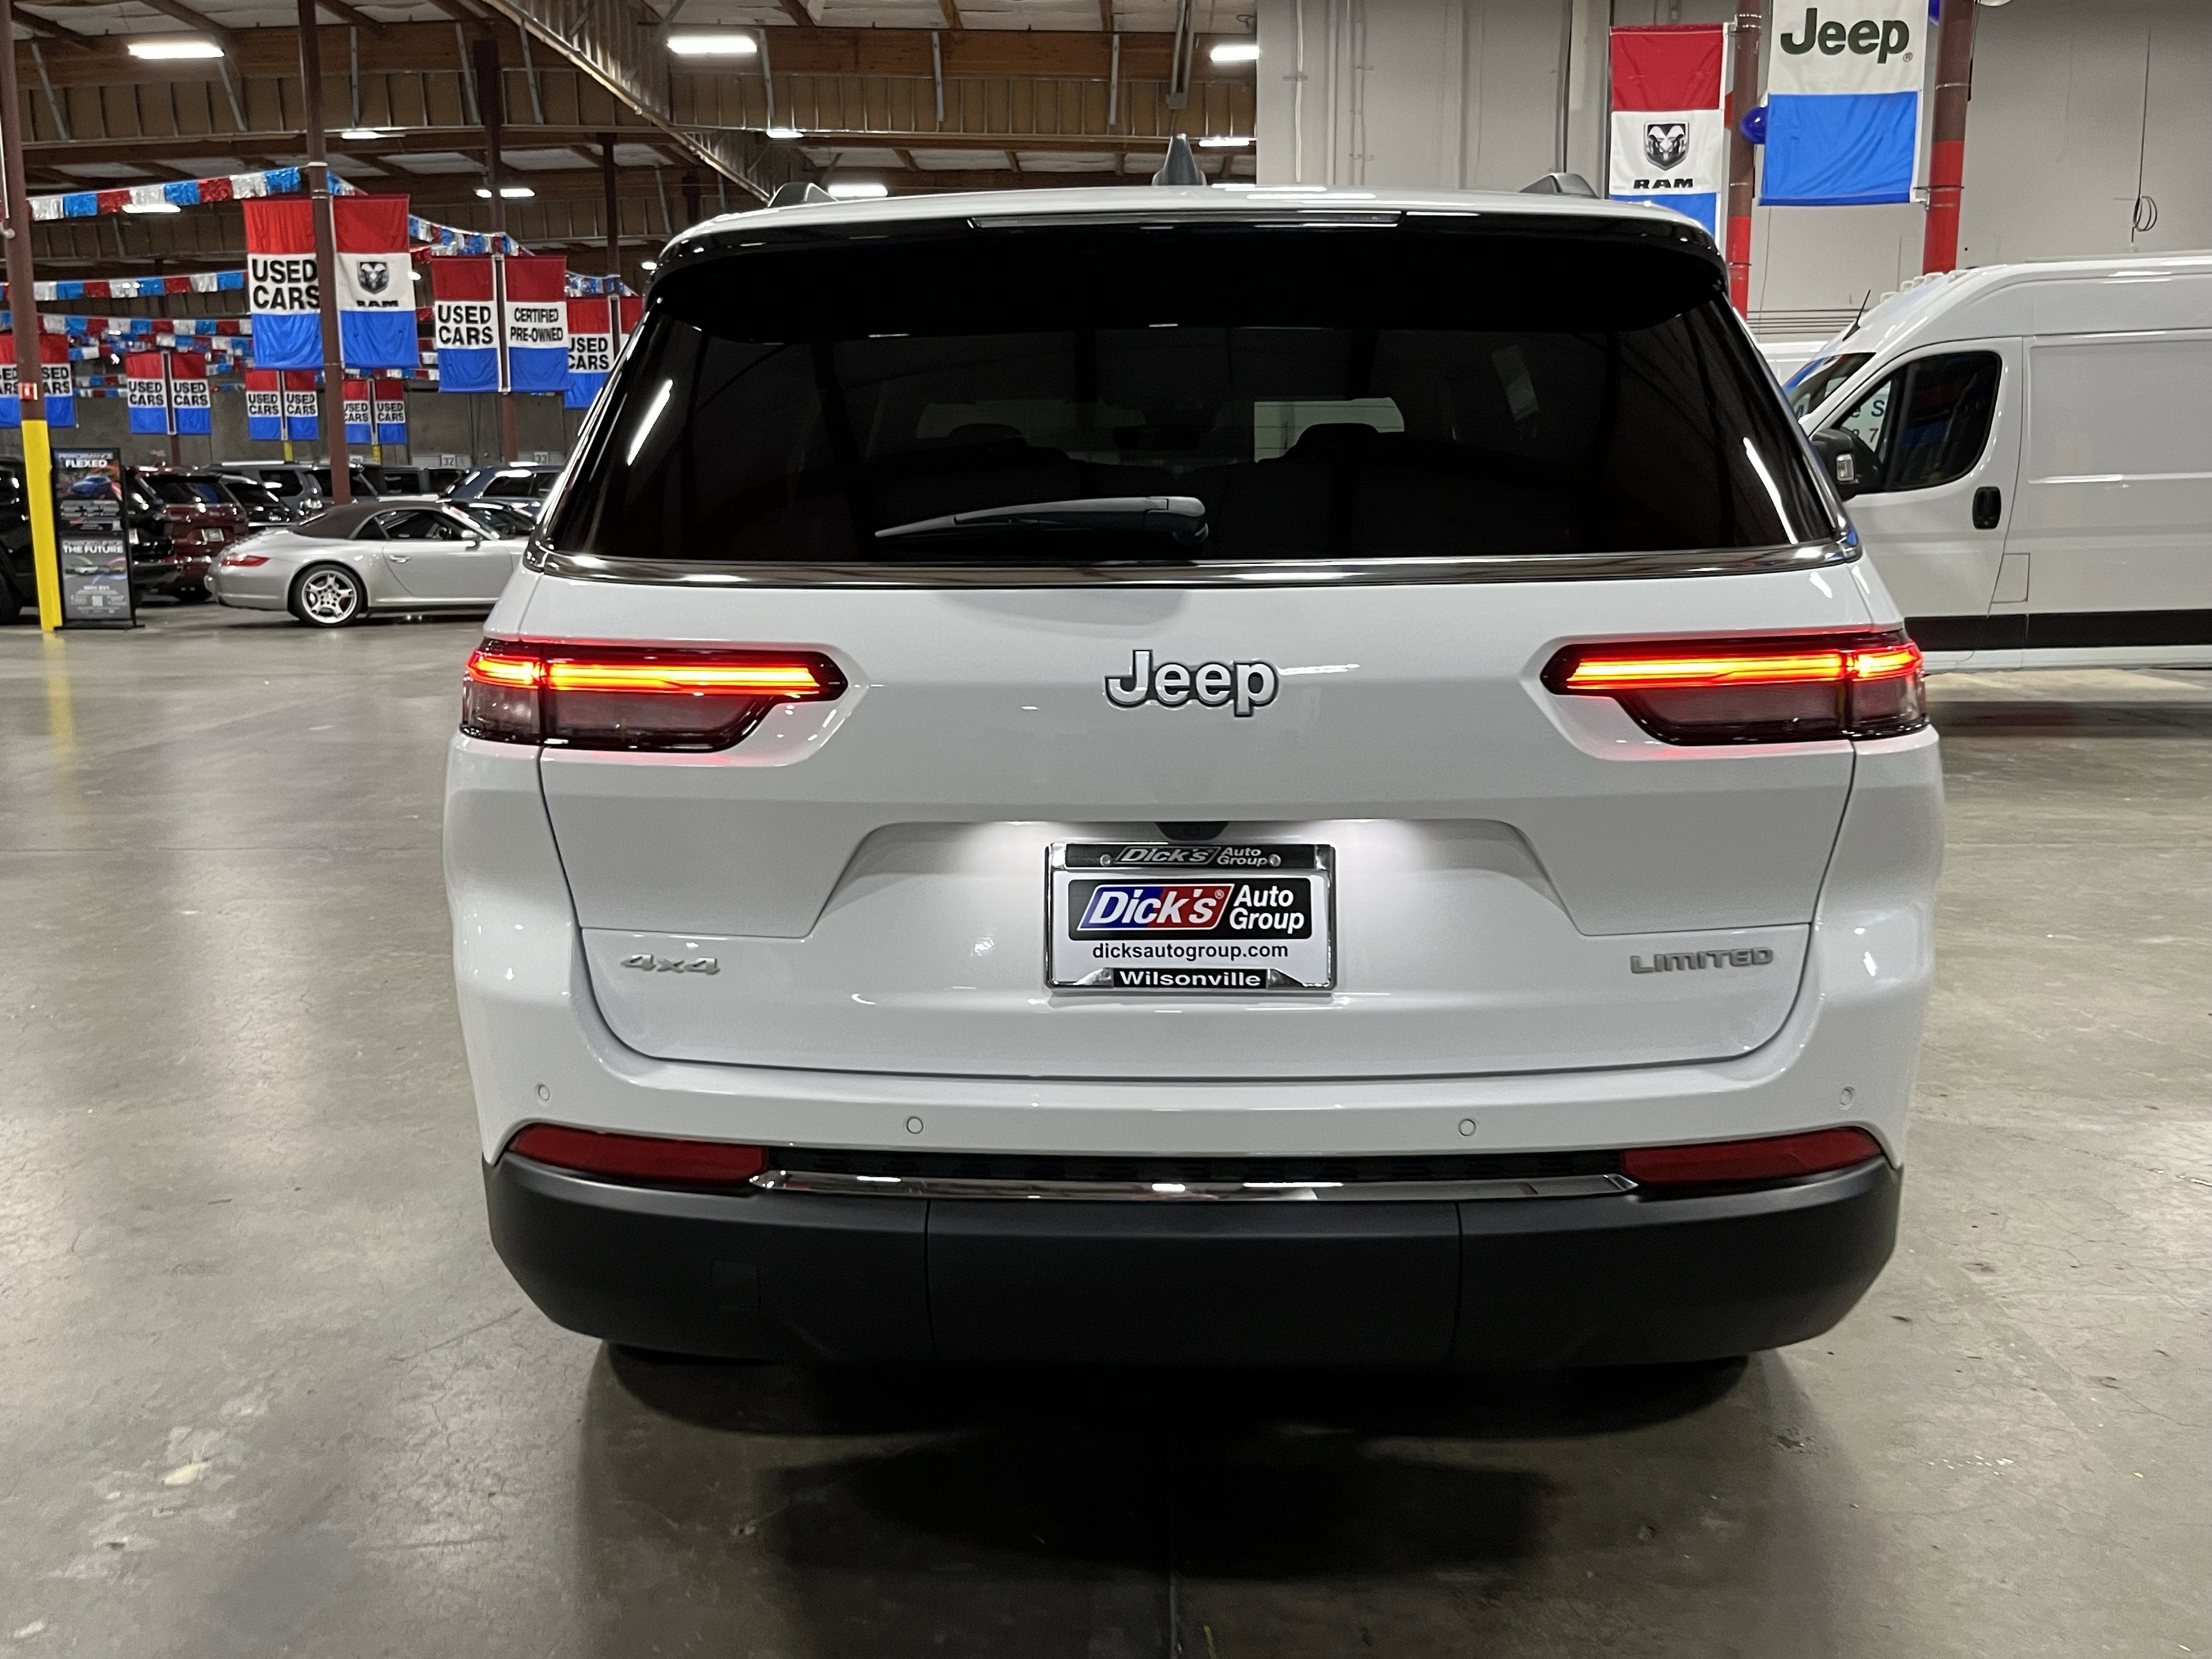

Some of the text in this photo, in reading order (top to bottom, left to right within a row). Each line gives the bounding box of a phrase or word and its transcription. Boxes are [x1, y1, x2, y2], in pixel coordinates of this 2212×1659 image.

[1780, 8, 1909, 64] Jeep
[1633, 178, 1694, 190] RAM
[252, 259, 317, 284] USED
[253, 285, 319, 309] CARS
[438, 304, 492, 324] USED
[514, 307, 559, 323] CERTIFIED
[439, 326, 494, 345] CARS
[510, 326, 563, 342] PRE-OWNED
[41, 367, 69, 379] SED
[43, 381, 70, 394] ARS
[128, 381, 163, 393] USED
[173, 382, 206, 393] USED
[129, 394, 164, 405] CARS
[173, 394, 208, 405] CARS
[248, 394, 278, 404] USED
[286, 393, 315, 404] USED
[249, 405, 279, 415] CARS
[286, 404, 317, 415] CARS
[376, 403, 403, 412] USED
[377, 413, 404, 422] CARS
[65, 459, 108, 468] FLEXED
[443, 457, 454, 466] 32
[63, 544, 123, 554] THE FUTURE
[1104, 649, 1279, 718] Jeep
[1120, 848, 1209, 862] Dick's
[1221, 847, 1261, 856] Auto
[1216, 855, 1268, 867] Group
[1233, 884, 1294, 907] Auto
[1088, 888, 1217, 924] Dick's
[1229, 907, 1305, 934] Group
[1092, 943, 1288, 962] dicksautogroup.com
[620, 953, 720, 975] 4x4
[1629, 946, 1774, 974] LIMITED
[1119, 970, 1261, 986] Wilsonville
